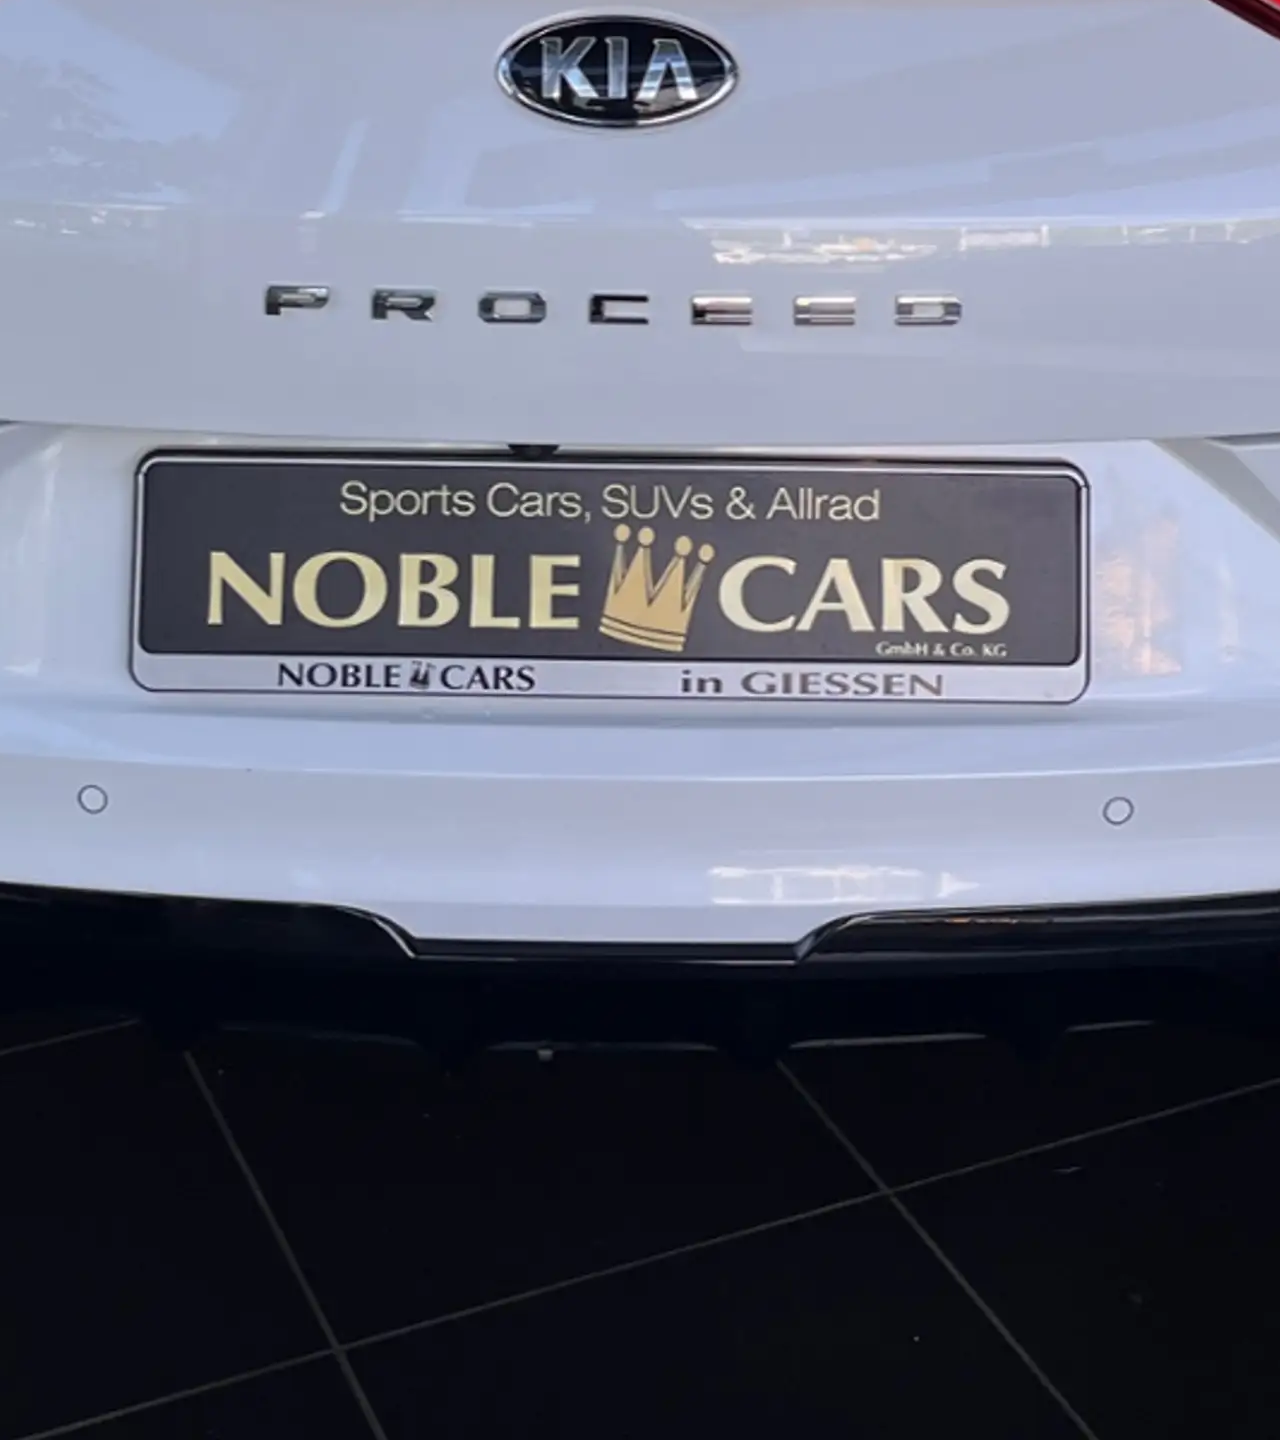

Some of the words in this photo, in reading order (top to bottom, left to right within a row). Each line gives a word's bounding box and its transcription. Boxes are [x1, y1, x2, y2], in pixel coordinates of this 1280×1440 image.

[539, 36, 699, 100] KIA
[265, 284, 963, 326] PROCEED
[339, 480, 476, 523] Sports
[486, 482, 591, 524] Cars,
[601, 483, 714, 521] SUVs
[725, 486, 757, 521] &
[766, 487, 881, 521] Allrad
[207, 550, 582, 629] NOBLE
[718, 554, 1011, 635] CARS
[874, 640, 929, 658] GmbH
[932, 642, 946, 657] &
[949, 641, 978, 658] Co.
[981, 642, 1008, 658] KG
[277, 662, 402, 690] NOBLE
[439, 664, 536, 692] CARS
[680, 669, 724, 696] in
[741, 670, 943, 698] GIESSEN
